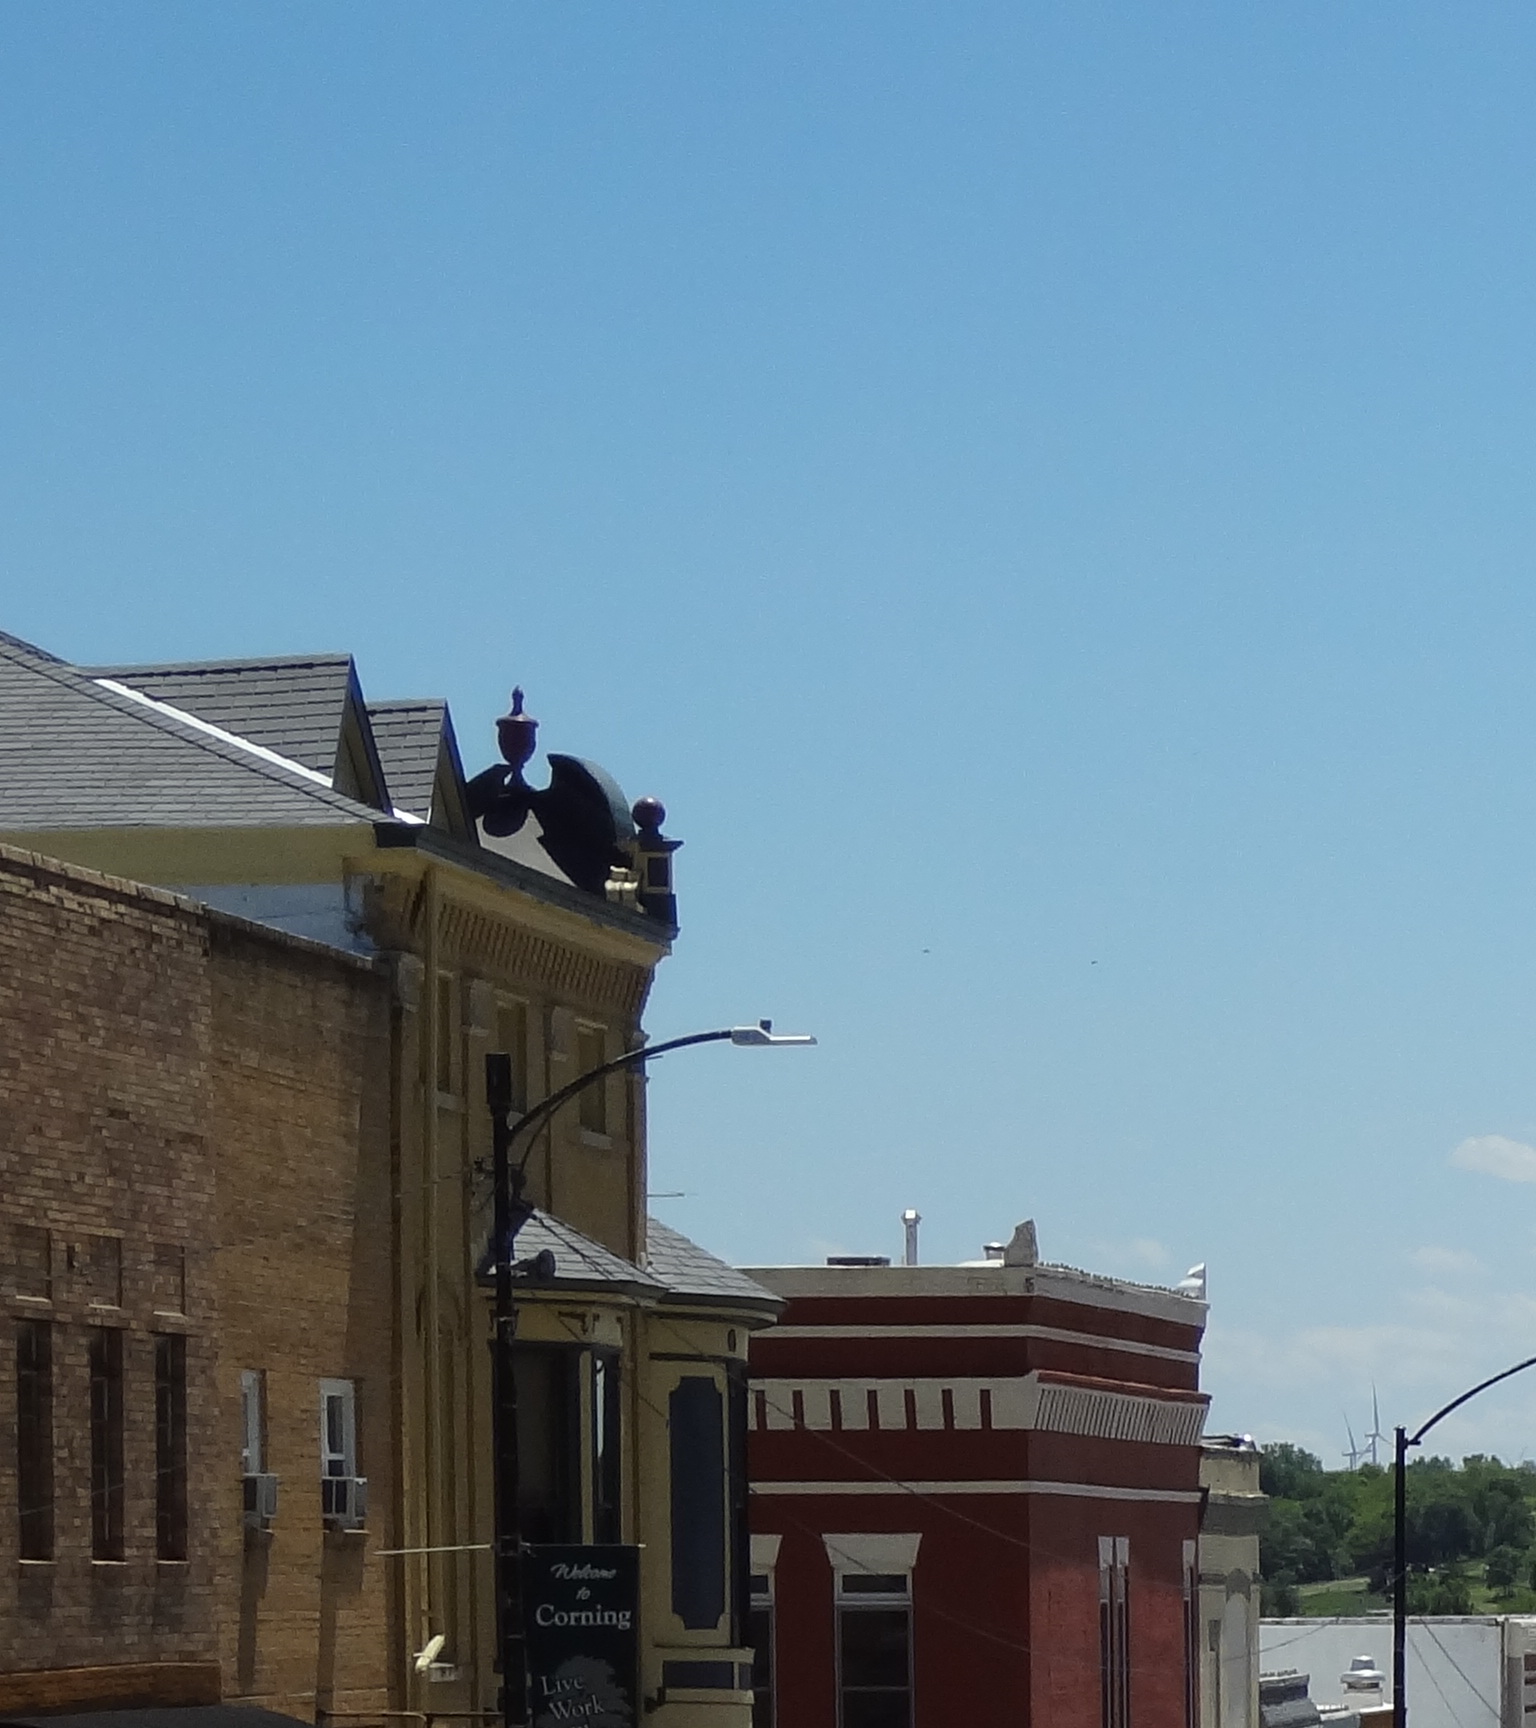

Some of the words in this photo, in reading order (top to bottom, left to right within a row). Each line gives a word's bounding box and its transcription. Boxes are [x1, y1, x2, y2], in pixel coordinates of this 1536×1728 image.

[549, 1563, 617, 1580] Welcome
[575, 1586, 591, 1600] to
[535, 1603, 632, 1630] Corning
[541, 1676, 585, 1696] Live
[548, 1694, 605, 1720] Work
